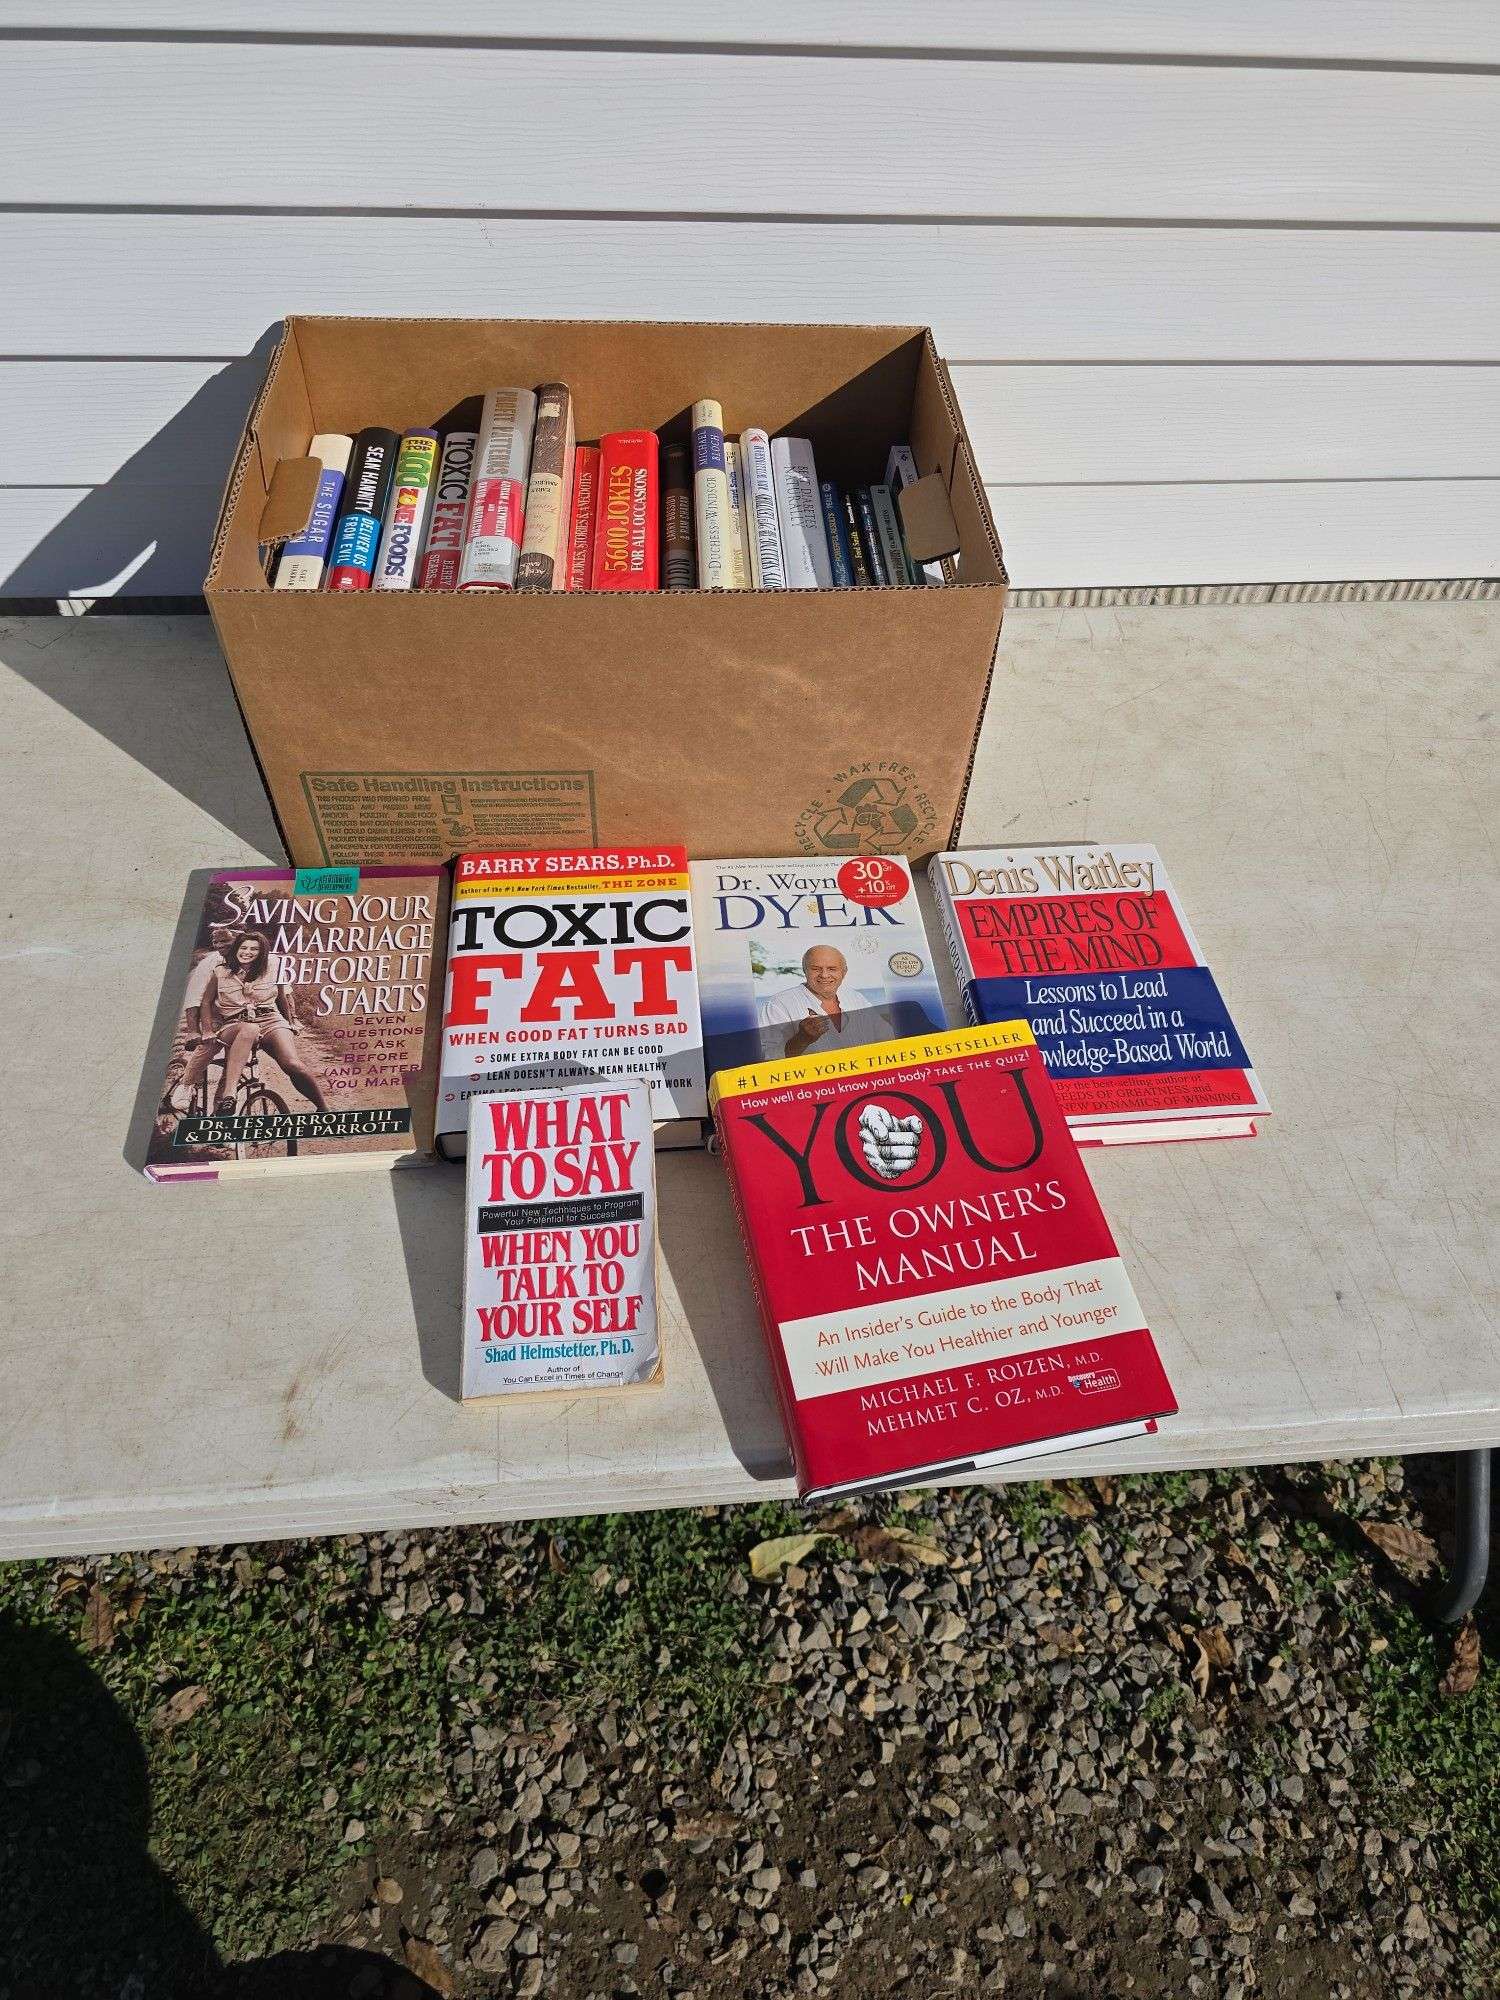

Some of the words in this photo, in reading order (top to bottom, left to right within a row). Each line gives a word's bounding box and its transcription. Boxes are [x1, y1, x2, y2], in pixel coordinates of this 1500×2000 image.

[363, 446, 385, 473] SEAN
[697, 430, 708, 466] MICHAEL
[711, 434, 721, 462] BLOCH
[437, 437, 475, 501] TOXIC
[320, 481, 336, 497] THE
[354, 472, 380, 515] HANNITY
[608, 465, 634, 525] JOKES
[632, 469, 648, 526] OCCASIONS
[704, 476, 718, 520] WINDSOR
[308, 503, 333, 543] SUGAR
[341, 516, 358, 541] FROM
[357, 516, 374, 551] DELIVER
[632, 527, 646, 548] ALL
[336, 543, 353, 565] EVIL
[352, 553, 367, 567] US
[384, 522, 411, 579] FOODS
[603, 526, 629, 572] 5600
[631, 549, 645, 571] FOR
[708, 523, 720, 568] DUCHESS
[311, 778, 358, 792] Safe
[363, 777, 457, 794] Handling
[460, 777, 585, 792] Instructions
[832, 763, 871, 783] WAX
[878, 762, 916, 782] FREE
[914, 792, 938, 845] RECYCLE
[794, 799, 823, 851] RECYCLE
[462, 857, 540, 876] BARRY
[545, 854, 625, 873] SEARS,
[627, 853, 676, 869] Ph.D.
[942, 856, 1040, 898] Denis
[1036, 850, 1156, 897] Waitley
[602, 880, 633, 889] THE
[636, 878, 678, 888] ZONE
[716, 874, 761, 892] Dr.
[767, 872, 837, 895] Wayn
[209, 885, 338, 928] SAVING
[345, 894, 434, 923] YOUR
[968, 898, 1115, 939] EMPIRES
[1116, 897, 1160, 932] OF
[268, 923, 433, 955] MARRIAGE
[452, 898, 691, 952] TOXIC
[274, 953, 399, 985] BEFORE
[399, 952, 431, 980] IT
[990, 936, 1067, 974] THE
[1062, 932, 1164, 970] MIND
[316, 982, 428, 1017] STARTS
[442, 945, 693, 1029] FAT
[1024, 978, 1097, 1005] Lessons
[1100, 980, 1118, 1001] to
[1119, 972, 1168, 999] Lead
[333, 1026, 424, 1039] QUESTIONS
[353, 1015, 407, 1026] SEVEN
[449, 1031, 501, 1047] WHEN
[506, 1029, 552, 1043] GOOD
[558, 1027, 589, 1040] FAT
[593, 1023, 650, 1039] TURNS
[655, 1022, 688, 1035] BAD
[1032, 1009, 1065, 1036] and
[1069, 1005, 1147, 1035] Succeed
[1149, 1006, 1168, 1029] in
[1171, 1010, 1185, 1027] a
[342, 1051, 409, 1064] BEFORE
[350, 1040, 369, 1050] TO
[373, 1039, 406, 1049] ASK
[489, 1052, 518, 1063] SOME
[520, 1051, 551, 1063] EXTRA
[553, 1049, 579, 1061] BODY
[582, 1048, 599, 1059] FAT
[601, 1047, 622, 1058] CAN
[623, 1046, 636, 1056] BE
[638, 1045, 664, 1055] GOOD
[736, 1075, 760, 1090] #1
[769, 1068, 807, 1085] NEW
[814, 1059, 859, 1077] YORK
[866, 1049, 918, 1069] TIMES
[923, 1031, 1025, 1059] BESTSELLER
[1174, 1031, 1233, 1062] World
[740, 1094, 769, 1110] How
[771, 1089, 795, 1105] well
[797, 1086, 813, 1100] do
[815, 1085, 837, 1101] you
[838, 1078, 871, 1094] know
[871, 1076, 897, 1093] your
[898, 1067, 932, 1087] body?
[934, 1063, 965, 1078] TAKE
[967, 1060, 993, 1073] THE
[995, 1050, 1031, 1068] QUIZ!
[185, 1131, 200, 1143] &
[207, 1130, 238, 1143] DR.
[241, 1126, 304, 1141] LESLIE
[312, 1121, 403, 1136] PARROTT
[199, 1118, 230, 1131] DR.
[233, 1117, 265, 1130] LES
[271, 1112, 363, 1128] PARROTT
[369, 1110, 392, 1122] III
[488, 1093, 631, 1152] WHAT
[738, 1067, 1046, 1209] YOU
[482, 1151, 547, 1202] TO
[554, 1141, 641, 1198] SAY
[482, 1209, 519, 1220] Powerful
[521, 1207, 541, 1217] New
[542, 1204, 591, 1216] Techniques
[593, 1203, 602, 1211] to
[604, 1199, 640, 1211] Program
[504, 1217, 525, 1226] Your
[527, 1214, 565, 1225] Potential
[566, 1213, 579, 1222] for
[579, 1210, 618, 1221] Success!
[789, 1215, 878, 1258] THE
[888, 1179, 1068, 1240] OWNER'S
[480, 1230, 573, 1268] WHEN
[580, 1223, 641, 1261] YOU
[854, 1230, 1038, 1293] MANUAL
[497, 1265, 580, 1303] TALK
[583, 1260, 626, 1297] TO
[476, 1301, 564, 1342] YOUR
[572, 1294, 644, 1334] SELF
[816, 1329, 841, 1348] An
[844, 1315, 914, 1342] Insider's
[918, 1304, 967, 1328] Guide
[970, 1302, 988, 1317] to
[990, 1294, 1018, 1312] the
[1021, 1285, 1062, 1310] Body
[1063, 1277, 1104, 1297] That
[484, 1344, 517, 1363] Shad
[815, 1355, 850, 1377] Will
[854, 1347, 901, 1369] Make
[902, 1340, 936, 1360] You
[940, 1324, 1014, 1353] Healthier
[1018, 1317, 1049, 1336] and
[1050, 1302, 1119, 1330] Younger
[503, 1376, 517, 1384] You
[518, 1375, 533, 1383] Can
[534, 1374, 555, 1382] Excel
[564, 1371, 586, 1380] Times
[596, 1370, 624, 1379] Change
[547, 1365, 573, 1374] Author
[860, 1377, 960, 1412] MICHAEL
[966, 1372, 981, 1389] F.
[987, 1353, 1071, 1383] ROIZEN,
[1075, 1352, 1104, 1366] M.D.
[1083, 1374, 1117, 1388] Health
[867, 1404, 960, 1438] MEHMET
[966, 1397, 989, 1414] C.
[995, 1387, 1031, 1409] OZ,
[1035, 1384, 1064, 1400] M.D.
